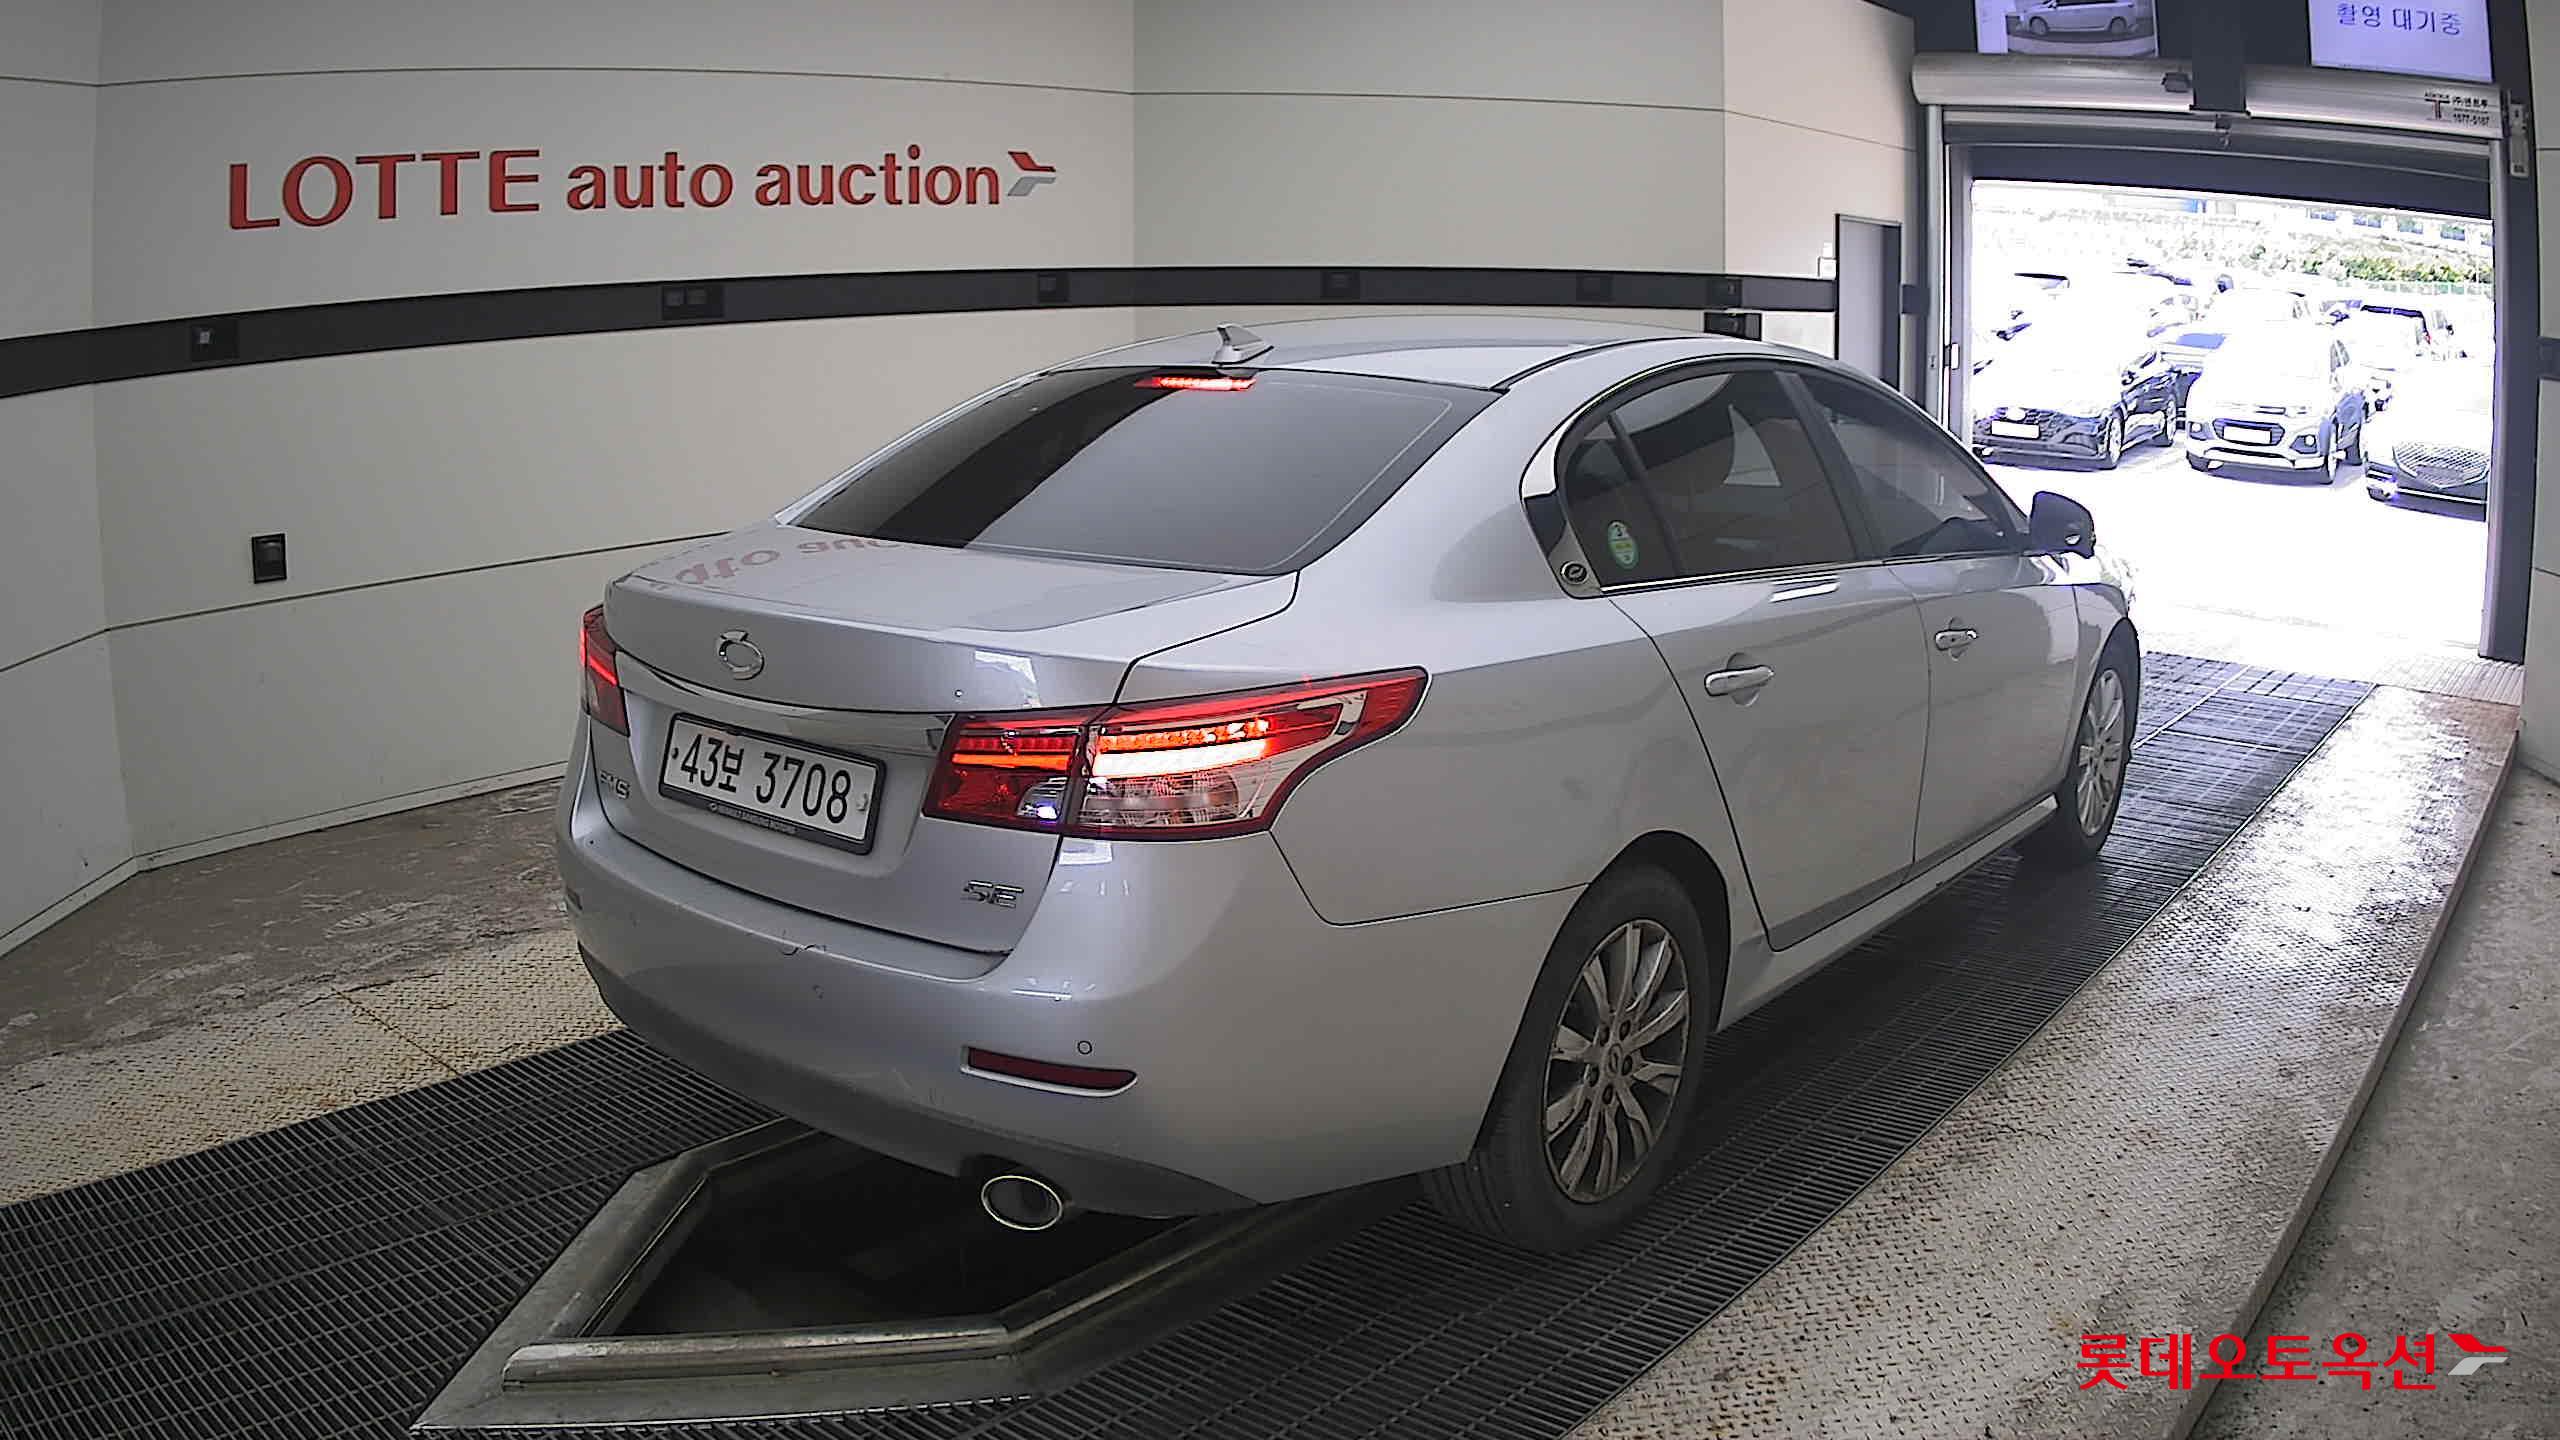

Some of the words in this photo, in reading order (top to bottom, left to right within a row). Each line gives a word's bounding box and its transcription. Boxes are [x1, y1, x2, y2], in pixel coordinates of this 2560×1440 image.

[2337, 3, 2382, 28] 촬영
[2392, 8, 2461, 36] 대기중
[228, 148, 540, 230] LOTTE
[566, 151, 734, 210] auto
[754, 143, 1000, 206] auction
[680, 733, 745, 793] 43보
[755, 751, 852, 824] 3708
